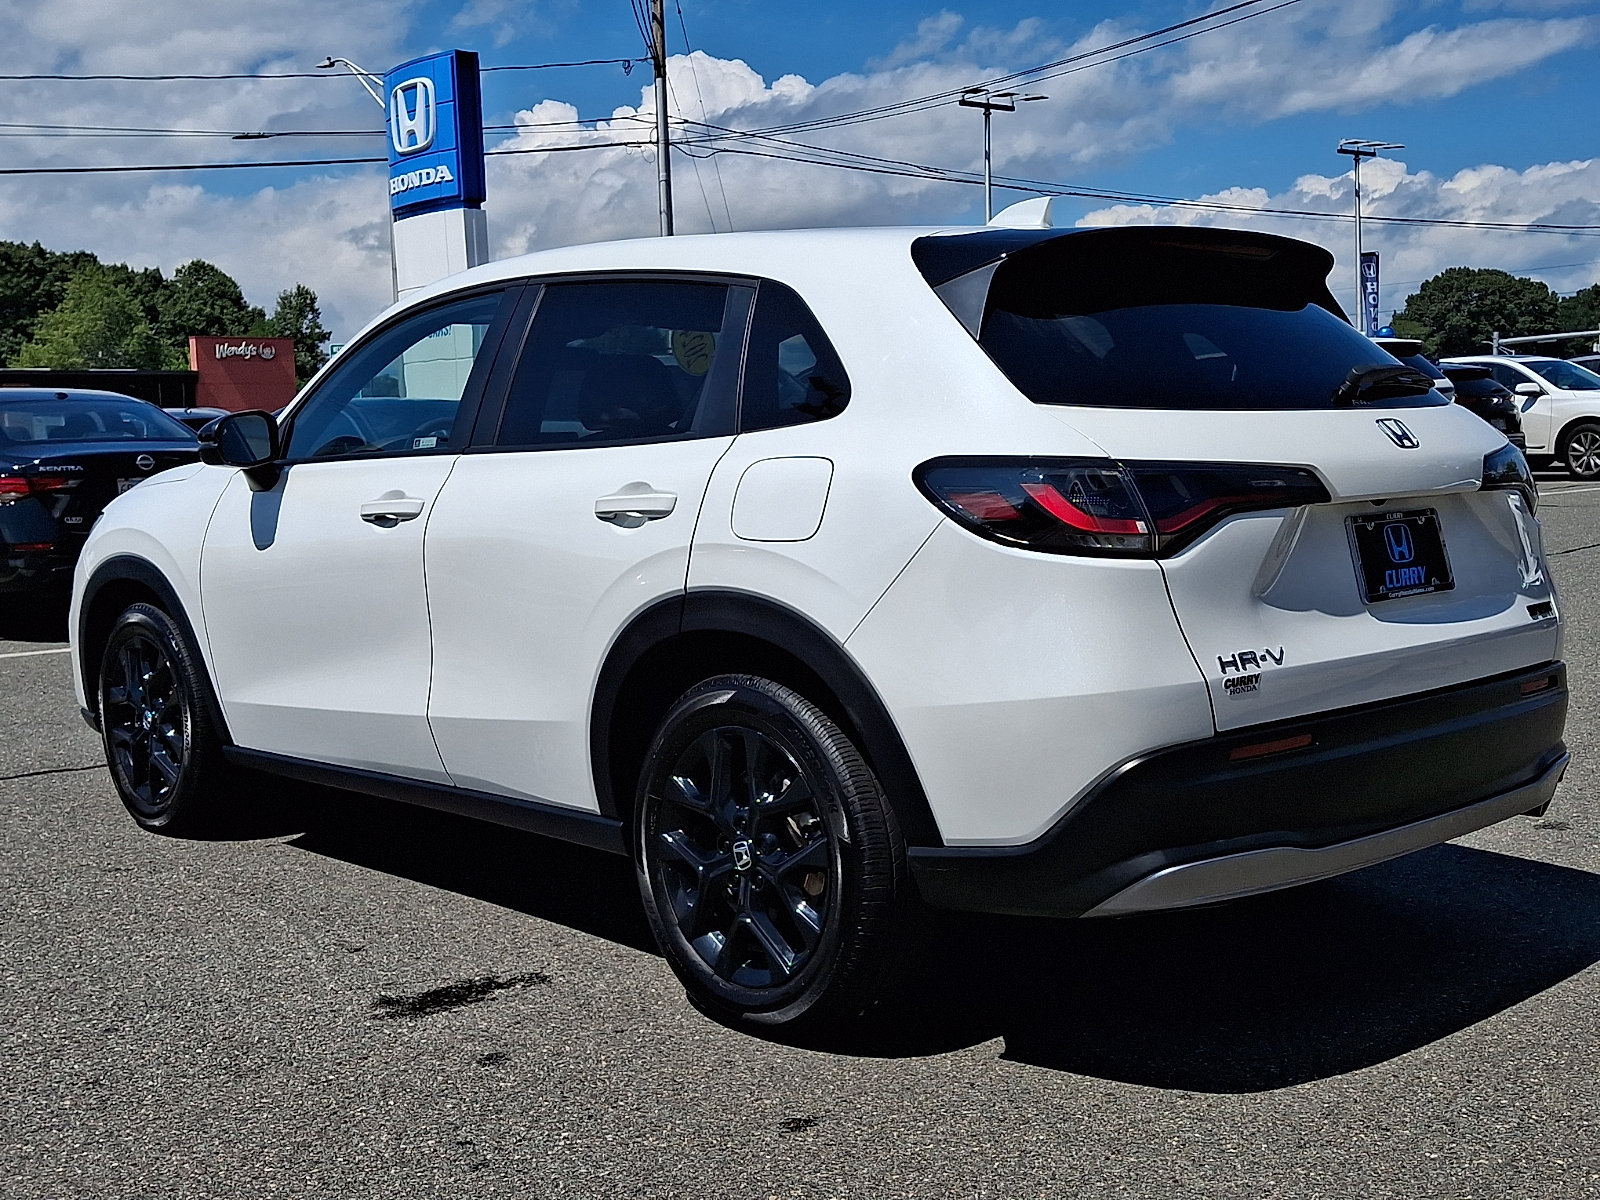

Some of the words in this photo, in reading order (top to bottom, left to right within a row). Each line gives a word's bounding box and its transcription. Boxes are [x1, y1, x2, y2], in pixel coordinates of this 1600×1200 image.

[390, 165, 454, 195] HONDA
[1366, 281, 1378, 337] HOND
[215, 341, 257, 360] Wendy's
[1385, 566, 1426, 588] CURRY
[1216, 645, 1285, 675] HR-V
[1223, 673, 1261, 690] CURRY
[1229, 684, 1258, 696] HONDA
